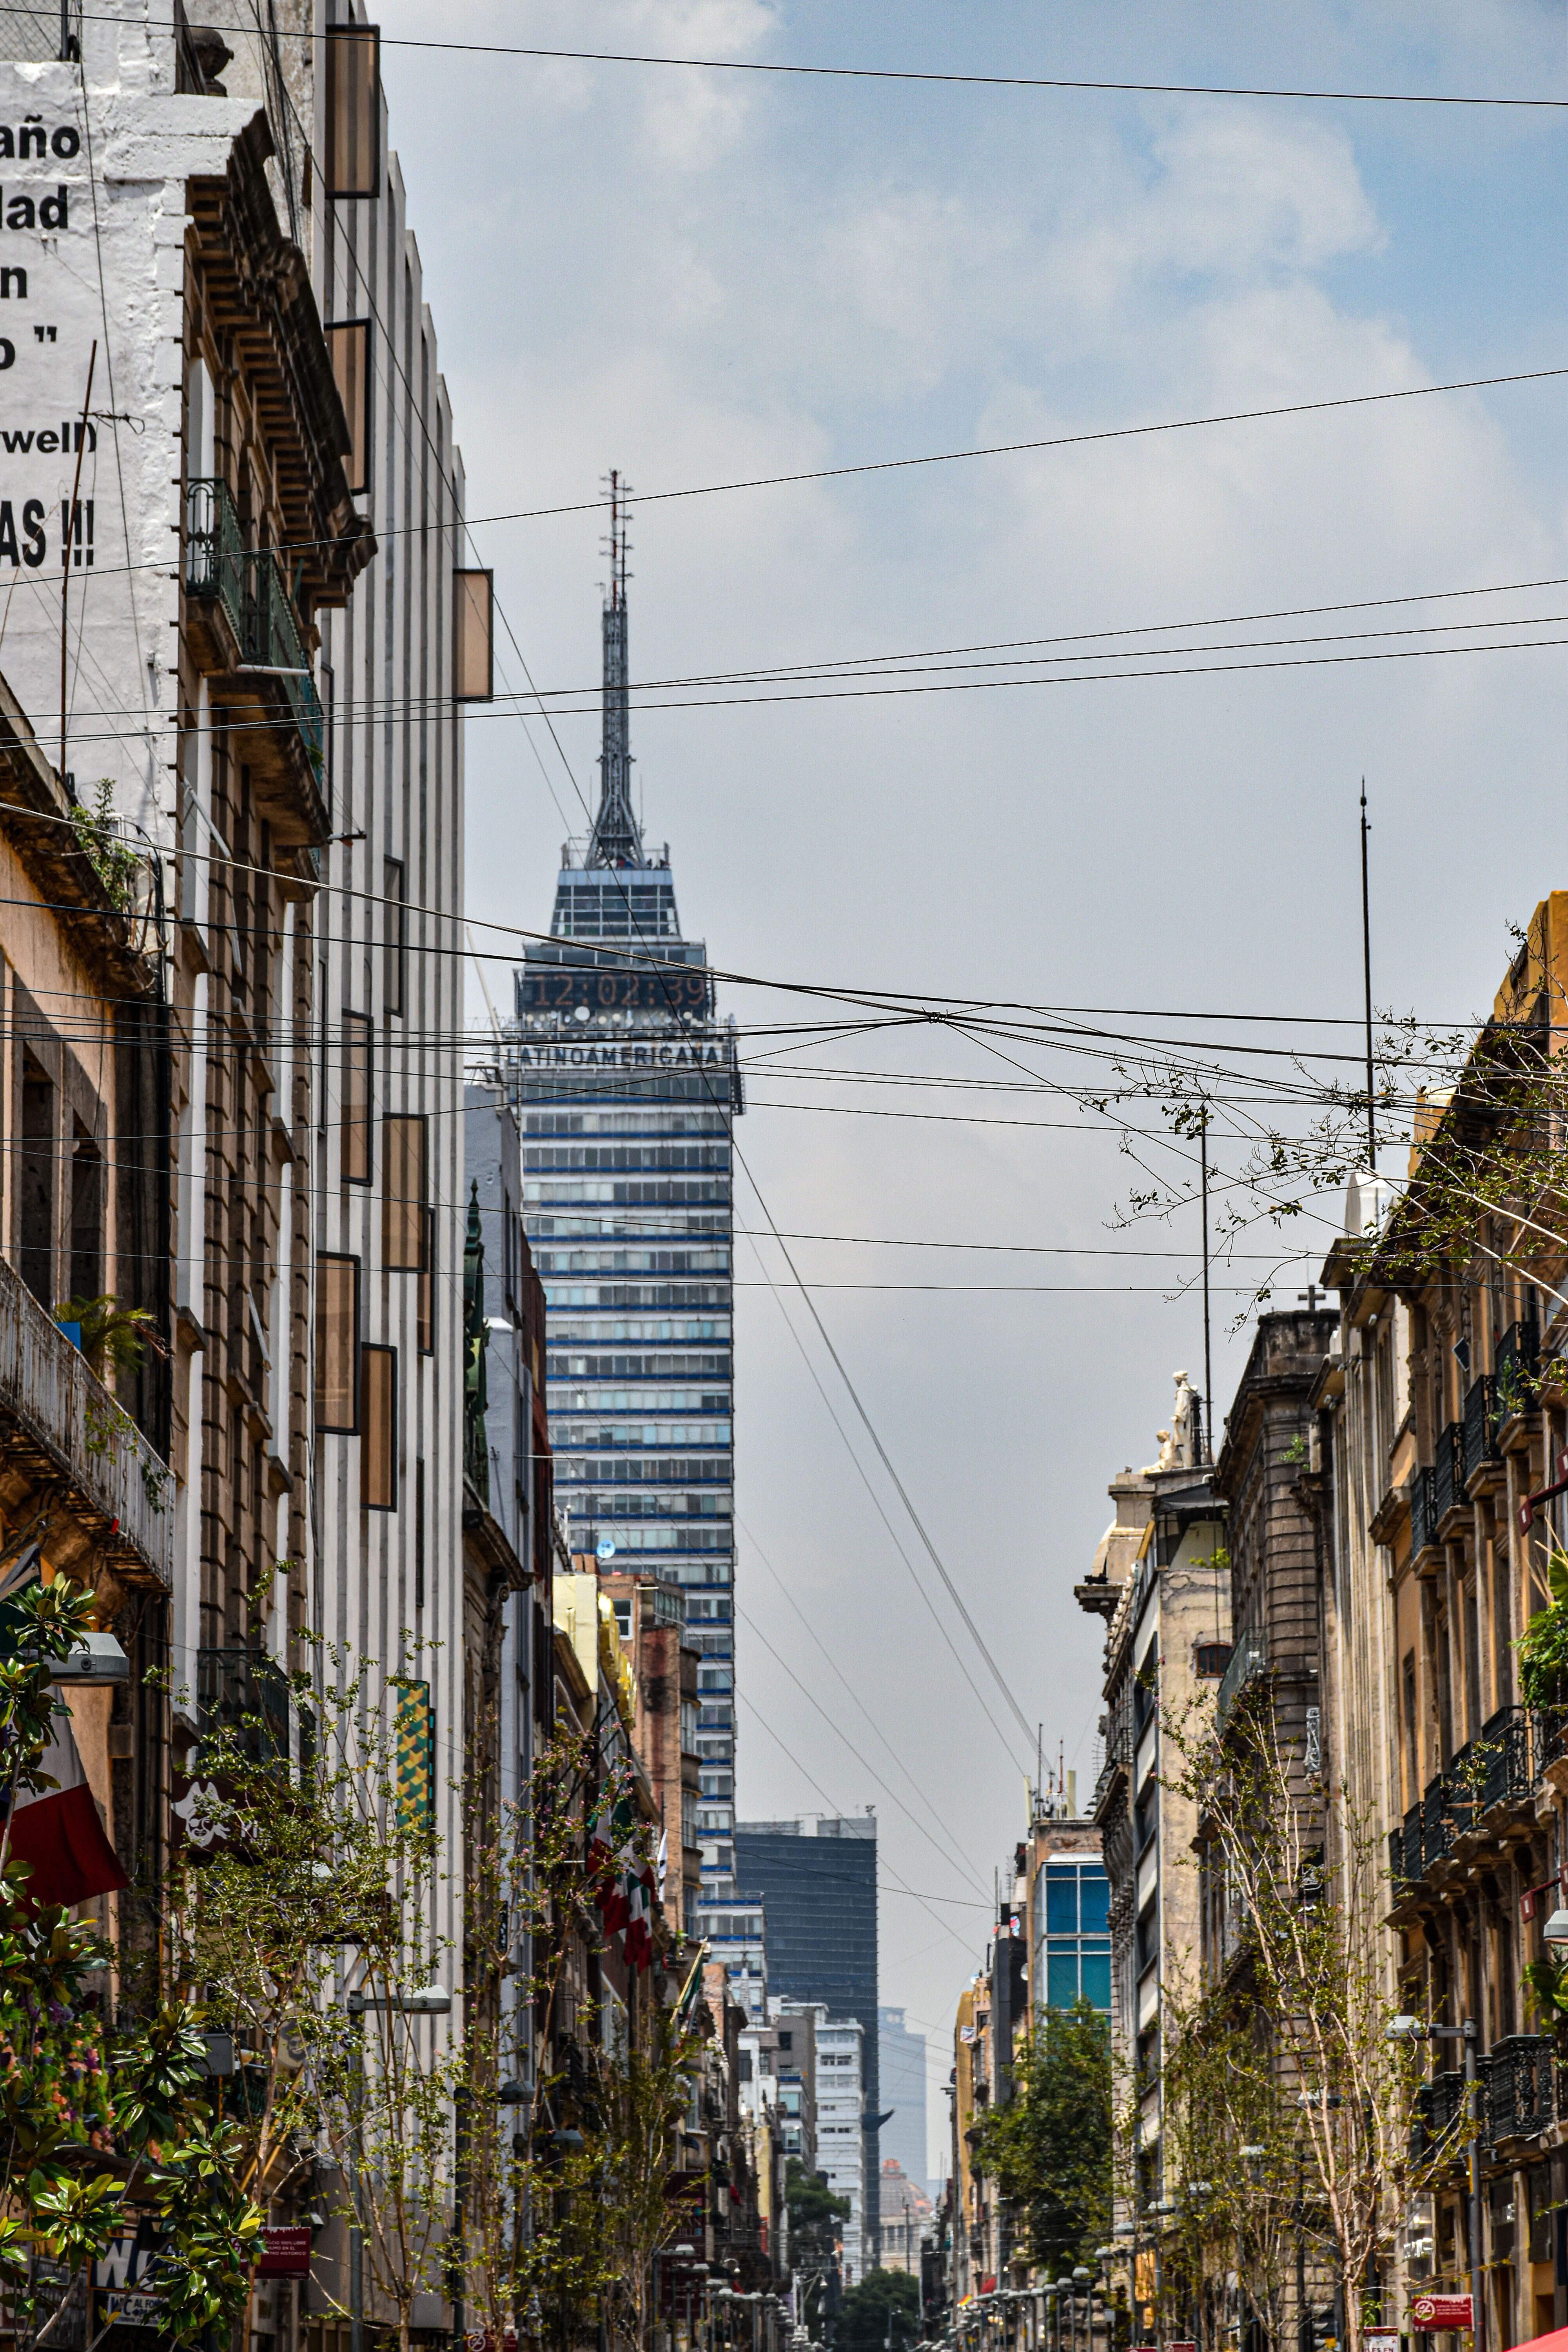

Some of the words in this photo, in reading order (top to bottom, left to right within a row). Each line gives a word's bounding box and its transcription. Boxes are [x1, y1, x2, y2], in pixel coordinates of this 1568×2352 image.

[0, 184, 68, 230] ad
[0, 422, 97, 454] well)
[534, 974, 705, 1006] 12:02:39
[507, 1046, 719, 1067] LATINOAMERICANA
